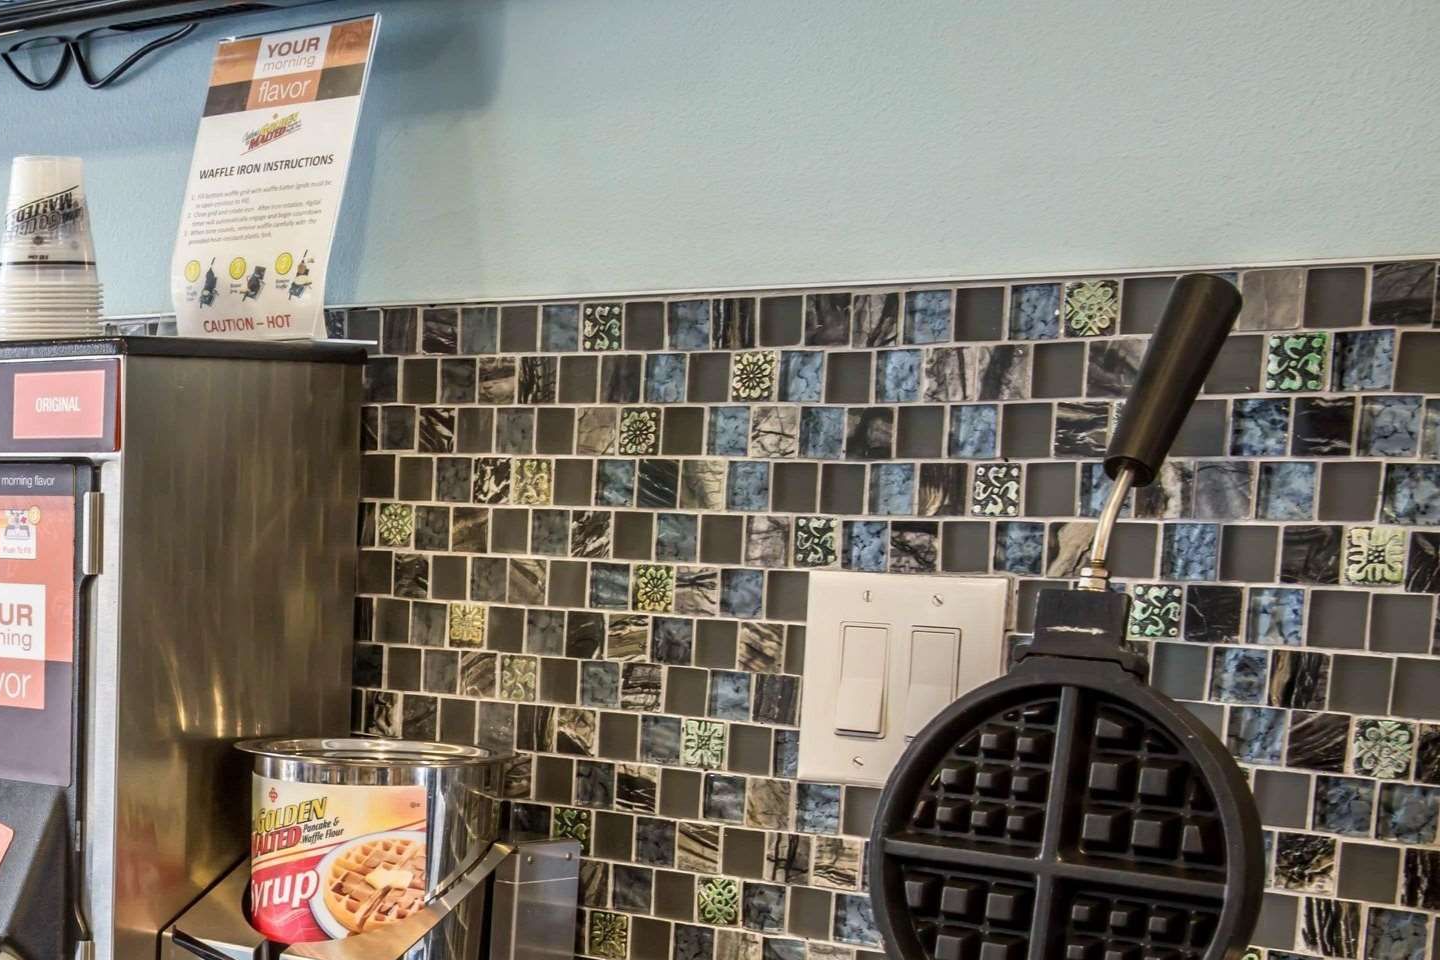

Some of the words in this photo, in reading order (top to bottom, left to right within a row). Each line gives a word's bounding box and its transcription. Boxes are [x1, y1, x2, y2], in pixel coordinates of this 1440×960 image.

[266, 36, 320, 58] YOUR
[262, 53, 317, 73] morning
[258, 79, 312, 103] flavor
[199, 166, 235, 180] WAFFLE
[237, 163, 261, 176] IRON
[263, 154, 334, 172] INSTRUCTIONS
[203, 317, 255, 333] CAUTION
[266, 314, 292, 328] HOT
[35, 396, 81, 413] ORIGINAL
[1, 475, 32, 488] morning
[34, 475, 56, 486] flavor
[255, 797, 328, 834] GOLDEN
[303, 820, 332, 833] Pancake
[333, 817, 340, 827] &
[252, 825, 301, 857] ALTED
[302, 832, 323, 845] Waffle
[325, 828, 345, 839] Flour
